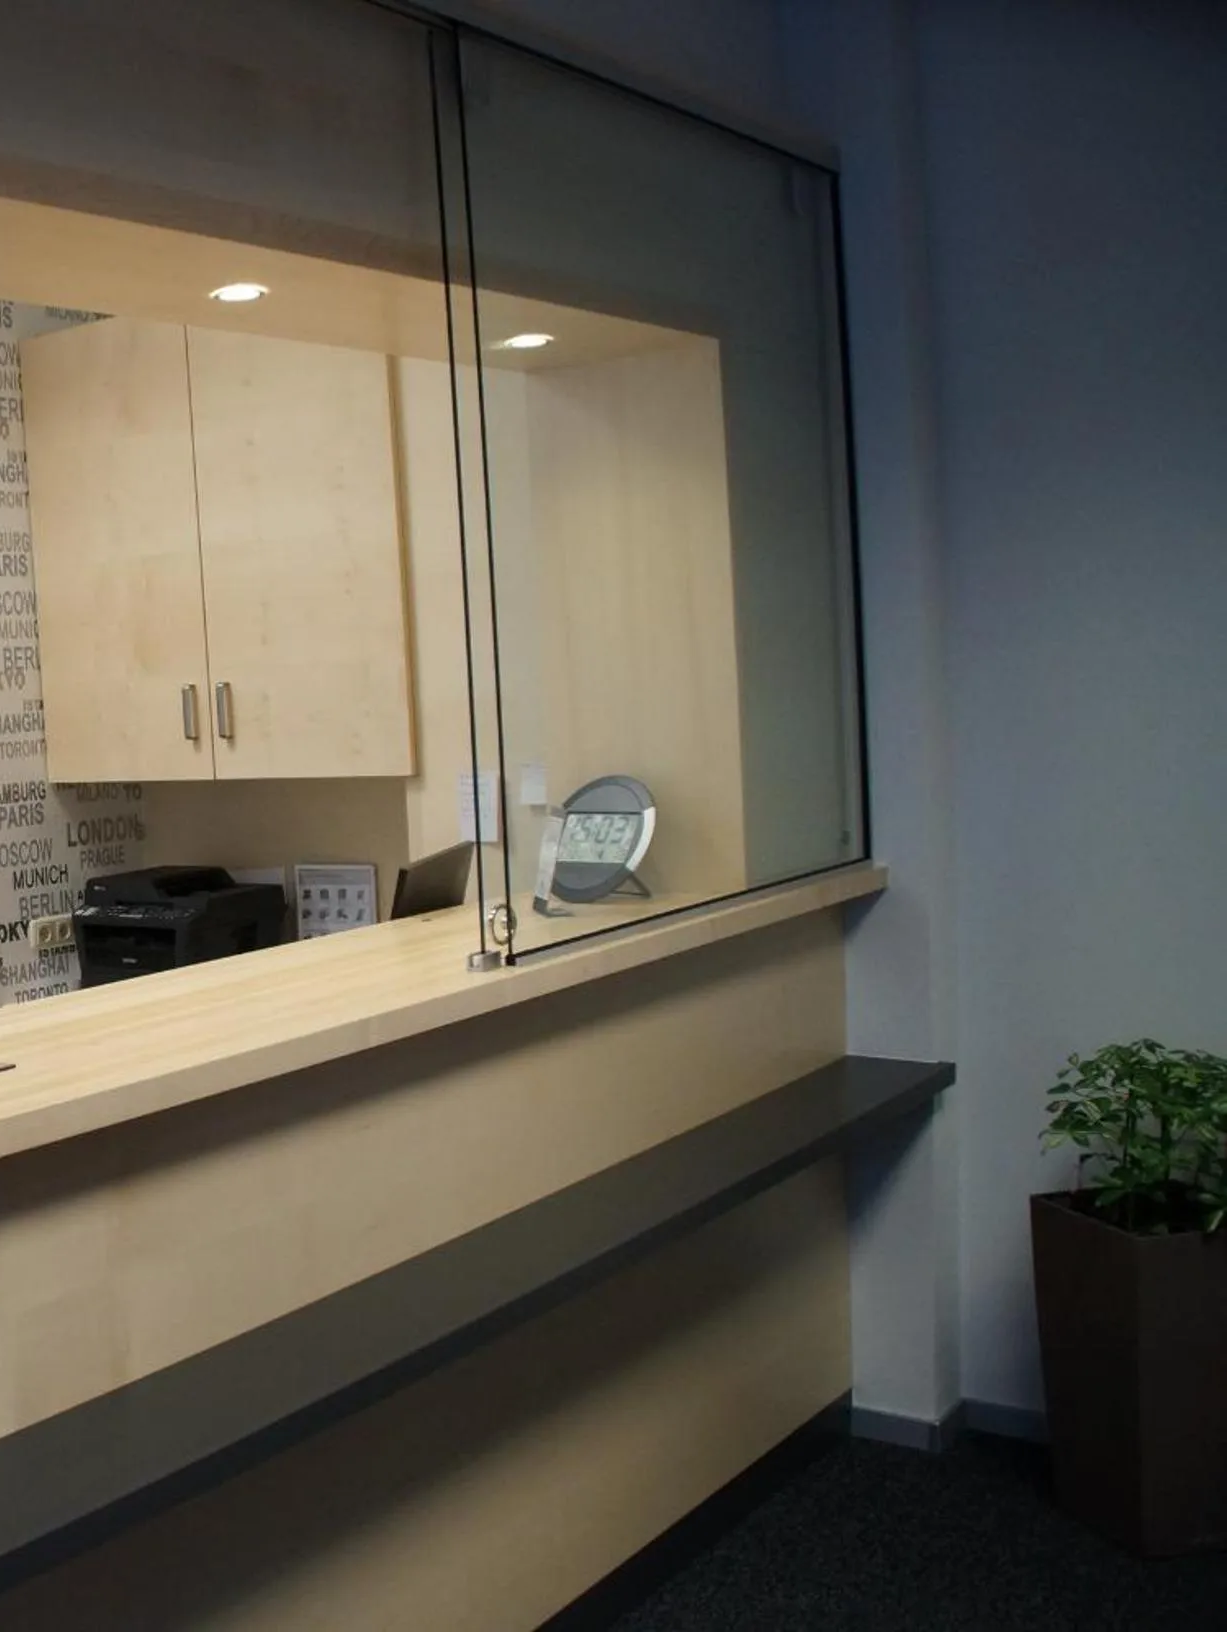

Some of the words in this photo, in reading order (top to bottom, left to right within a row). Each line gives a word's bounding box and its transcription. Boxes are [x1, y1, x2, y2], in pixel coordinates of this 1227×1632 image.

[67, 814, 139, 848] LONDON
[80, 846, 125, 870] PRAGUE
[13, 864, 69, 891] MUNICH
[19, 890, 72, 920] BERLIN
